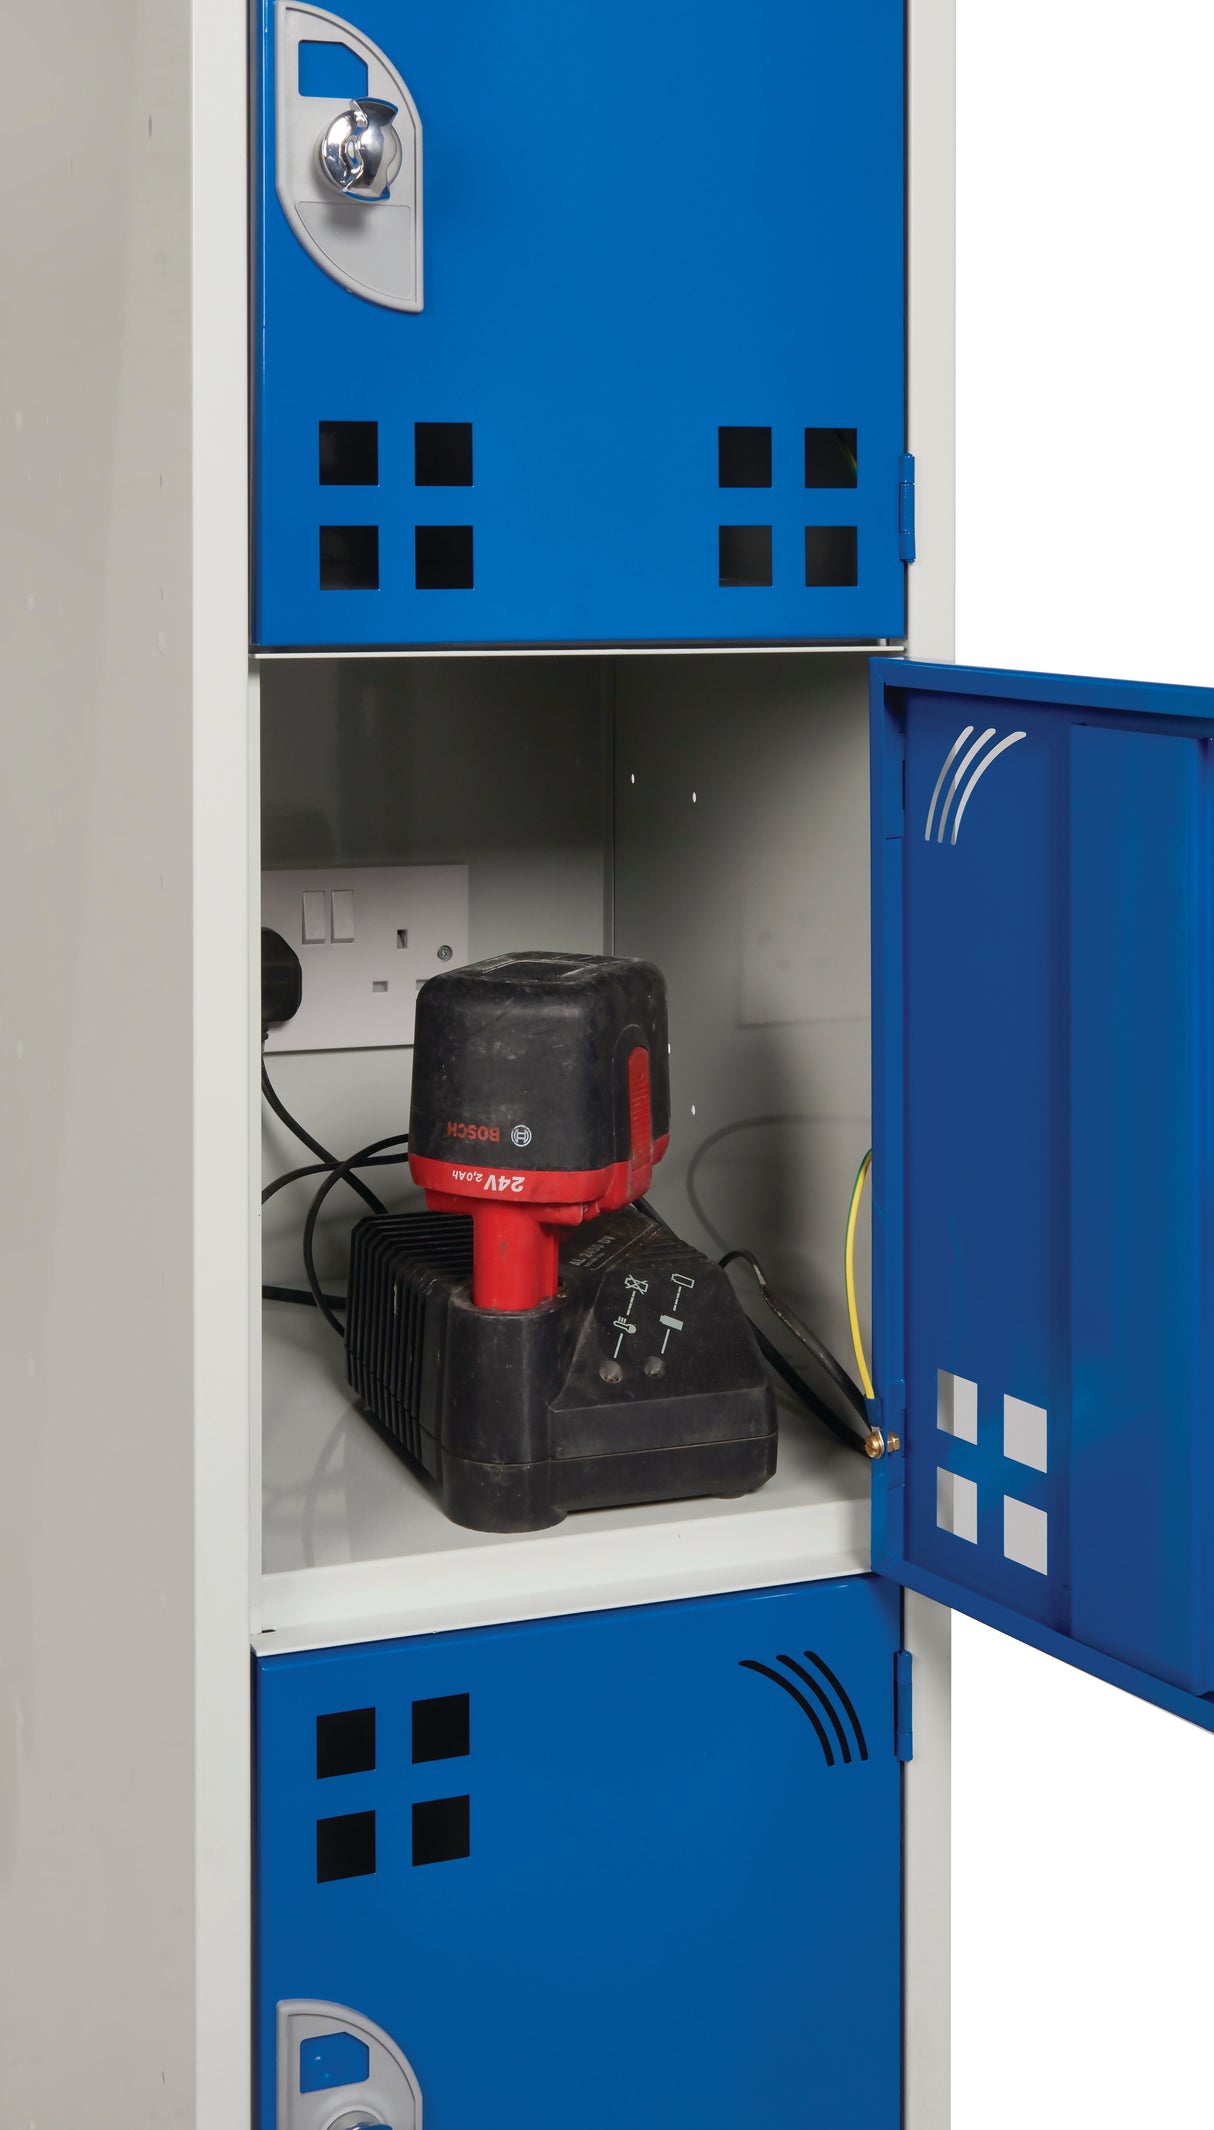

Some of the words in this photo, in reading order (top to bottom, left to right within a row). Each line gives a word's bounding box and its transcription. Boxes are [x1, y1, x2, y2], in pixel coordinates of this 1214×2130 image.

[447, 1121, 500, 1142] BOSCH
[452, 1169, 484, 1182] 2,0Ah
[483, 1174, 525, 1192] 24V
